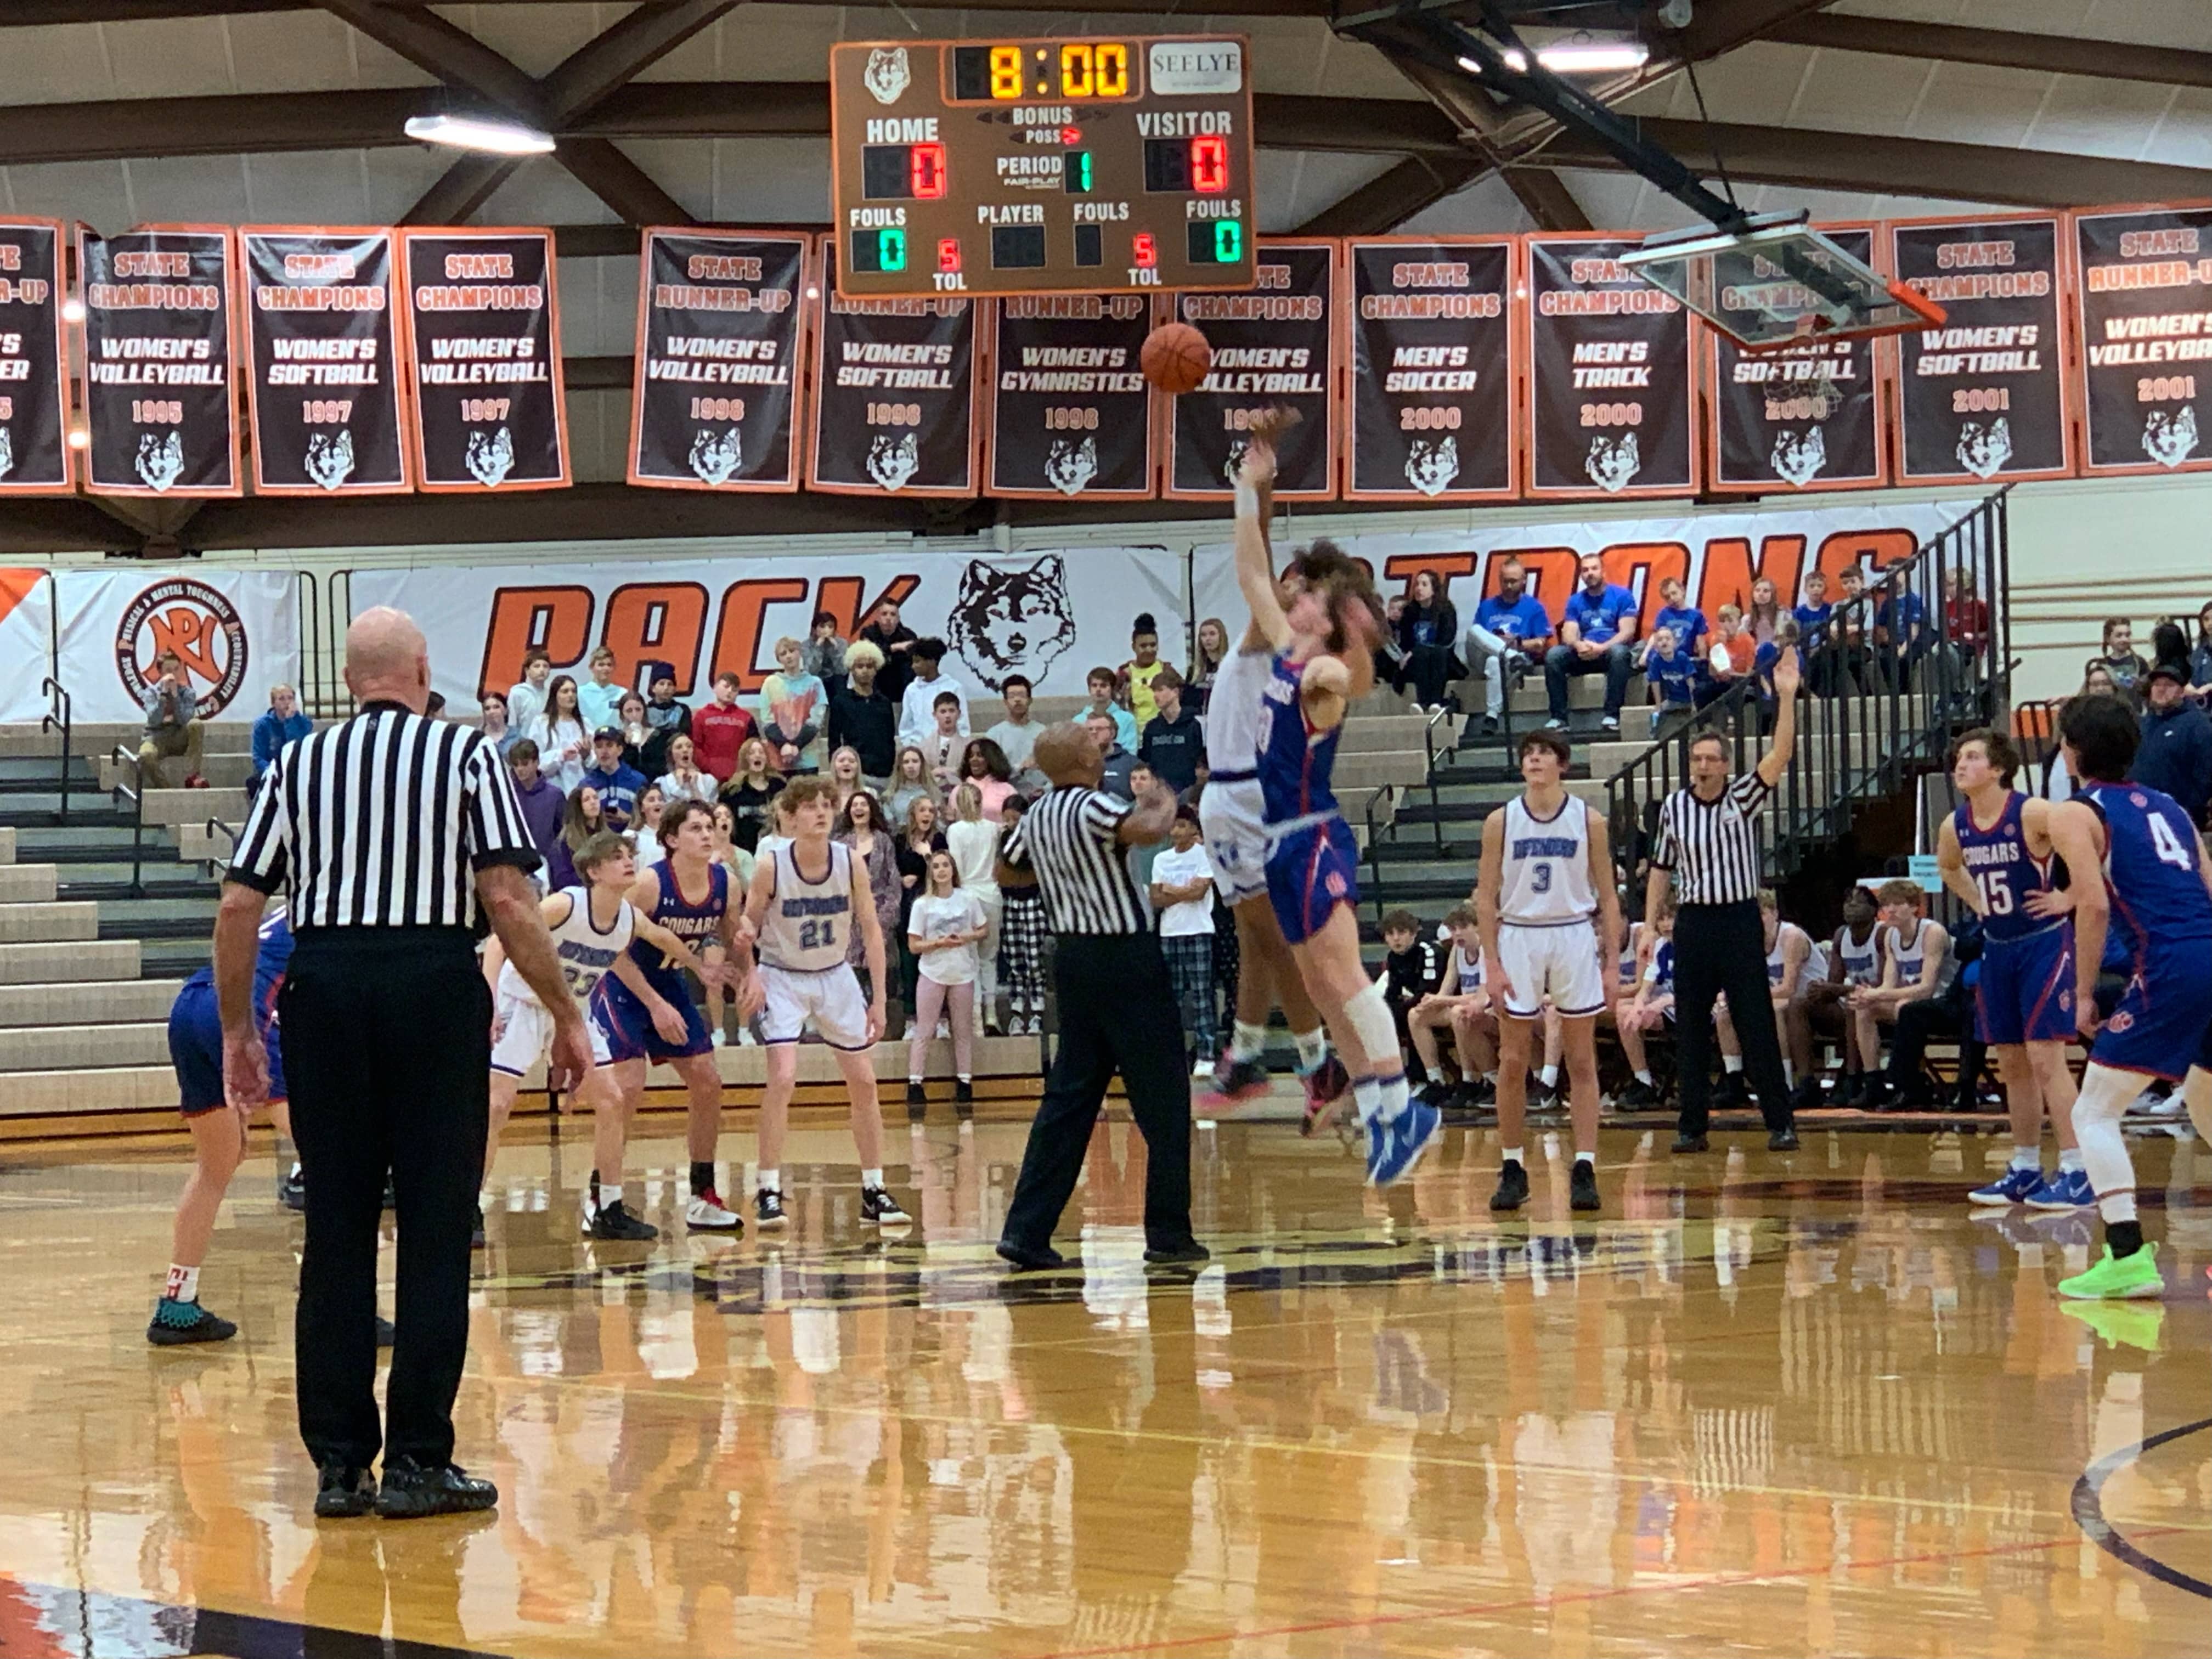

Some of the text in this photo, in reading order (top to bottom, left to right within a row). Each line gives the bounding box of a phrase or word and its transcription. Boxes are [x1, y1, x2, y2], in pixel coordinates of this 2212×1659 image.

[990, 44, 1127, 99] 8:00
[1154, 53, 1238, 72] SEELYE
[1013, 106, 1073, 125] BONUS
[1137, 111, 1232, 137] VISITOR
[867, 118, 938, 143] HOME
[1025, 129, 1060, 144] POSS
[911, 143, 945, 198] 0
[997, 156, 1062, 176] PERIOD
[1192, 137, 1228, 193] 0
[850, 207, 906, 227] FOULS
[978, 202, 1129, 224] PLAYER FOULS
[1186, 200, 1242, 218] FOULS
[879, 229, 905, 271] 0
[1133, 233, 1156, 267] 5
[1216, 221, 1241, 263] 0
[1937, 240, 2015, 268] STATE
[2119, 228, 2199, 257] STATE
[115, 252, 190, 277] STATE
[285, 255, 356, 279] STATE
[445, 254, 514, 278] STATE
[938, 239, 960, 272] 5
[689, 256, 763, 280] STATE
[1128, 268, 1161, 286] TOL
[1393, 263, 1469, 287] STATE
[1571, 258, 1646, 284] STAT
[2087, 258, 2212, 292] RUNNER-U
[933, 273, 967, 291] TOL
[89, 284, 219, 309] CHAMPIONS
[257, 286, 385, 311] CHAMPIONS
[416, 285, 543, 312] CHAMPIONS
[655, 285, 791, 313] RUNNER-UP
[1006, 296, 1143, 320] RUNNER-UP
[1182, 296, 1323, 320] CHAMPIONS
[1361, 292, 1501, 319] CHAMPIONS
[101, 338, 210, 359] WOMEN'S
[273, 338, 377, 360] WOMEN'S
[431, 337, 535, 359] WOMEN'S
[666, 336, 778, 361] WOMEN'S
[1922, 325, 2039, 350] WOMEN'S
[842, 342, 953, 365] WOMEN'S
[1022, 347, 1127, 368] WOMEN'S
[1392, 347, 1469, 367] MEN'S
[1572, 342, 1649, 363] MEN'S
[1916, 350, 2041, 376] SOFTBALL
[2089, 337, 2212, 366] VOLLEYBA
[89, 363, 225, 385] VOLLEYBALL
[268, 364, 379, 385] SOFTBALL
[420, 362, 549, 383] VOLLEYBALL
[648, 360, 789, 385] VOLLEYBALL
[836, 366, 953, 390] SOFTBALL
[1001, 371, 1144, 392] GYMNASTICS
[1194, 373, 1324, 392] LLEYBALL
[1385, 370, 1477, 392] SOCCER
[1572, 366, 1652, 388] TRACK
[1733, 359, 1857, 383] SOFTBALL
[1953, 388, 2010, 413] 2001
[2137, 376, 2196, 402] 2001
[132, 400, 183, 424] 1995
[302, 400, 353, 424] 1997
[461, 398, 511, 421] 1997
[690, 397, 745, 421] 1998
[866, 402, 921, 426] 1998
[1045, 408, 1098, 430] 1998
[1400, 407, 1462, 430] 2000
[1580, 403, 1643, 426] 2000
[1765, 396, 1827, 421] 2000
[117, 606, 144, 651] PHYSICAL
[150, 584, 183, 601] MENTAL
[187, 584, 230, 619] TOUGHNESS
[477, 574, 921, 703] PACK
[220, 621, 244, 699] ACCOUNTABILITY
[2146, 812, 2192, 871] 4
[1962, 842, 2020, 866] COUGARS
[1531, 862, 1553, 894] 3
[1976, 870, 2013, 916] 15
[799, 919, 836, 952] 21
